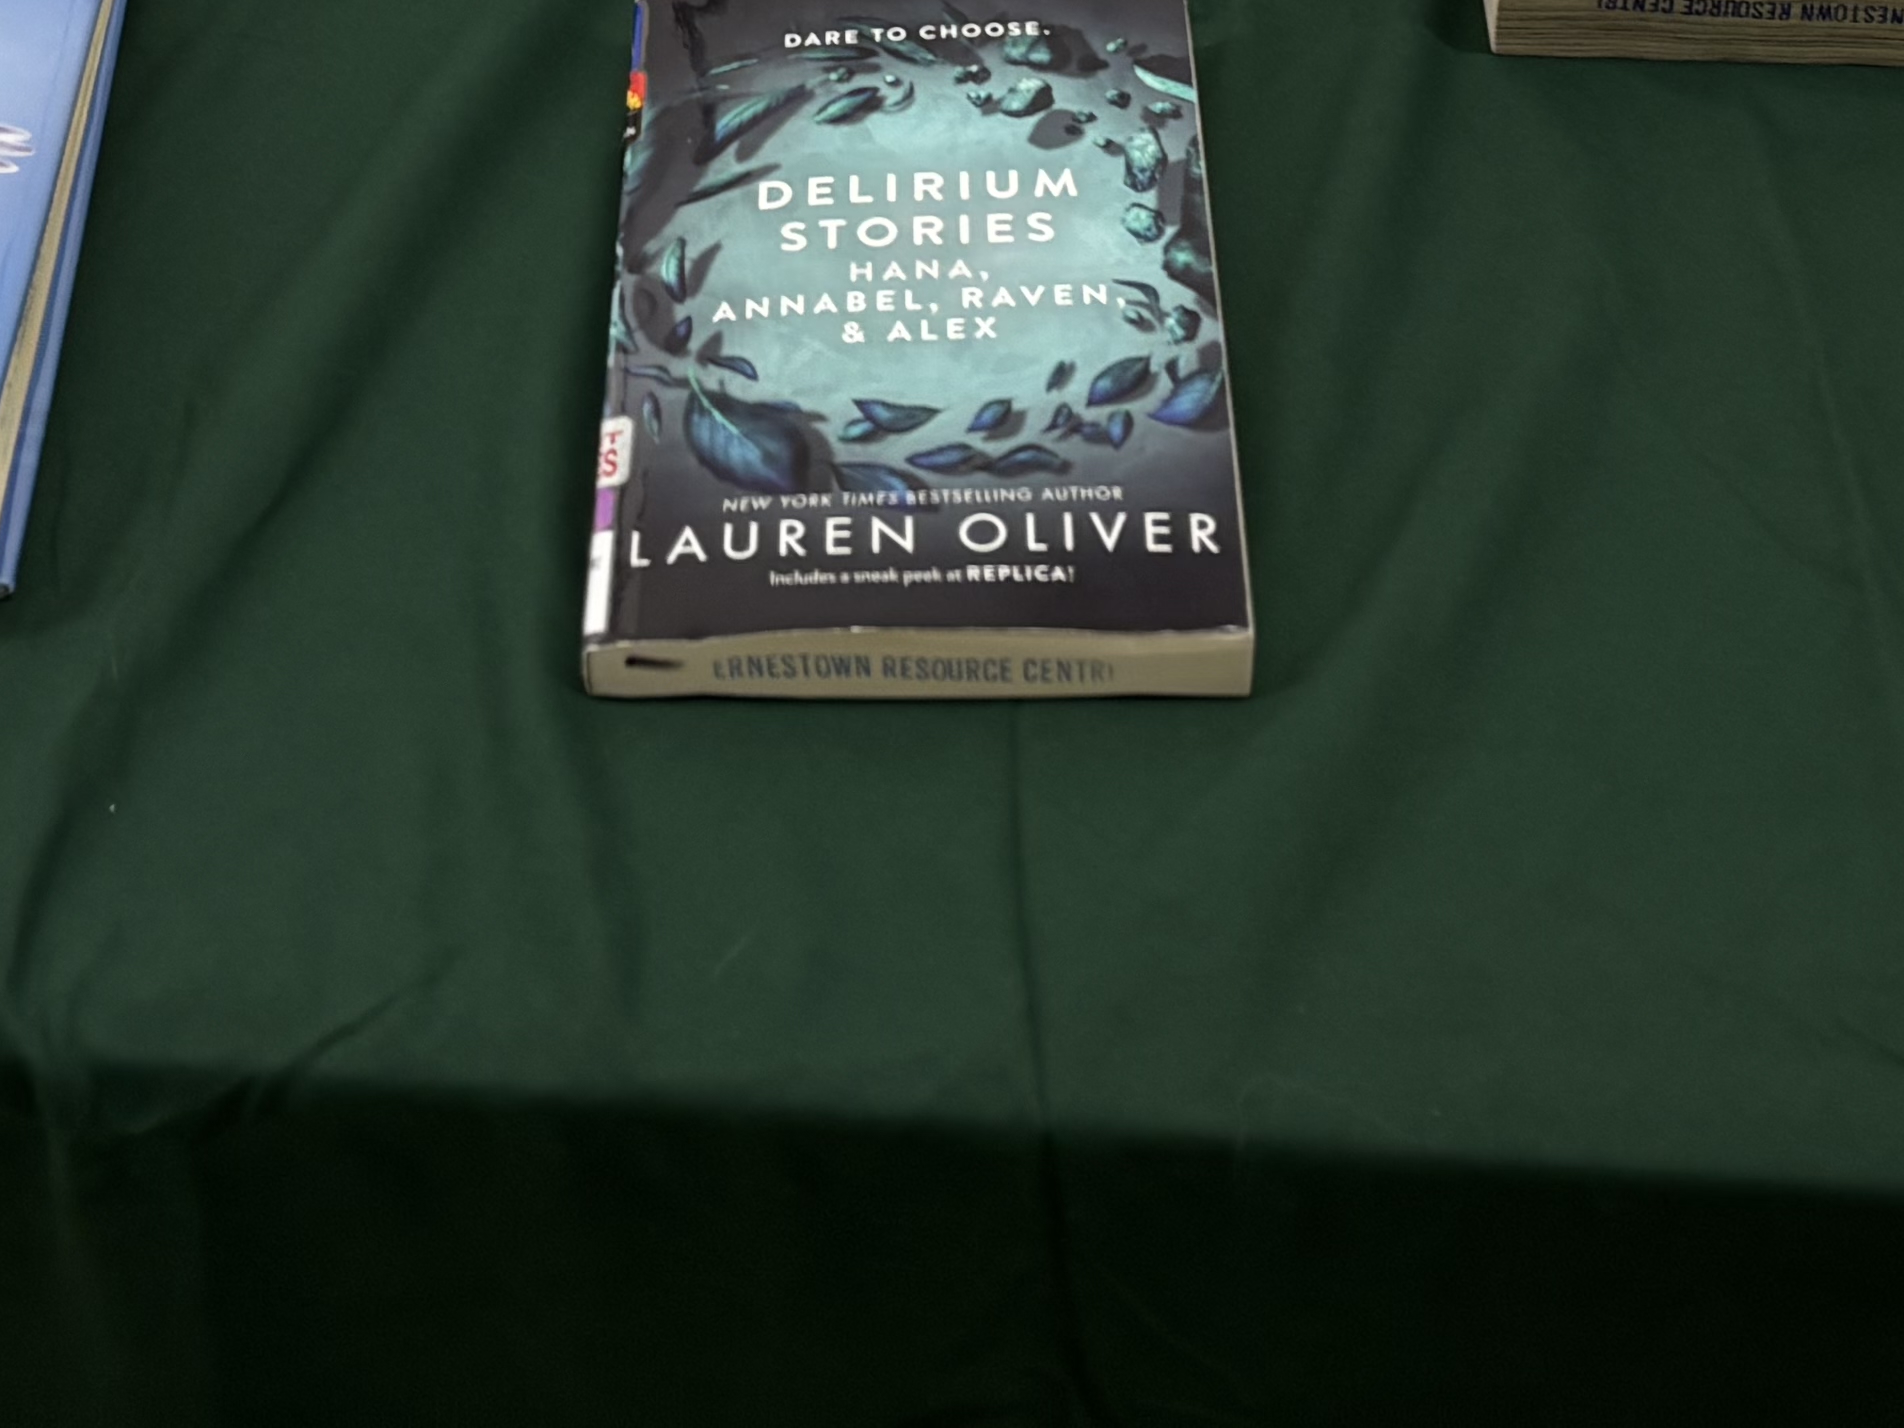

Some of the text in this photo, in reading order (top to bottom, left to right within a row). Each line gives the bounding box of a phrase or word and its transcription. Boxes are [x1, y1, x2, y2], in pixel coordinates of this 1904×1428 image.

[783, 20, 1052, 49] DARE TO CHOOSE.
[757, 168, 1079, 211] DELIRIUM
[780, 211, 1056, 253] STORIES
[849, 259, 991, 284] HANA,
[711, 283, 1127, 324] ANNABEL, RAVEN,
[841, 316, 998, 344] & ALEX
[722, 485, 1125, 514] NEW YORK TIMES BESTSELLING AUTHOR
[628, 511, 1222, 568] LAUREN OLIVER
[769, 563, 1076, 587] Includes sneak peek REPLICA!
[881, 655, 1013, 683] RESOURCE
